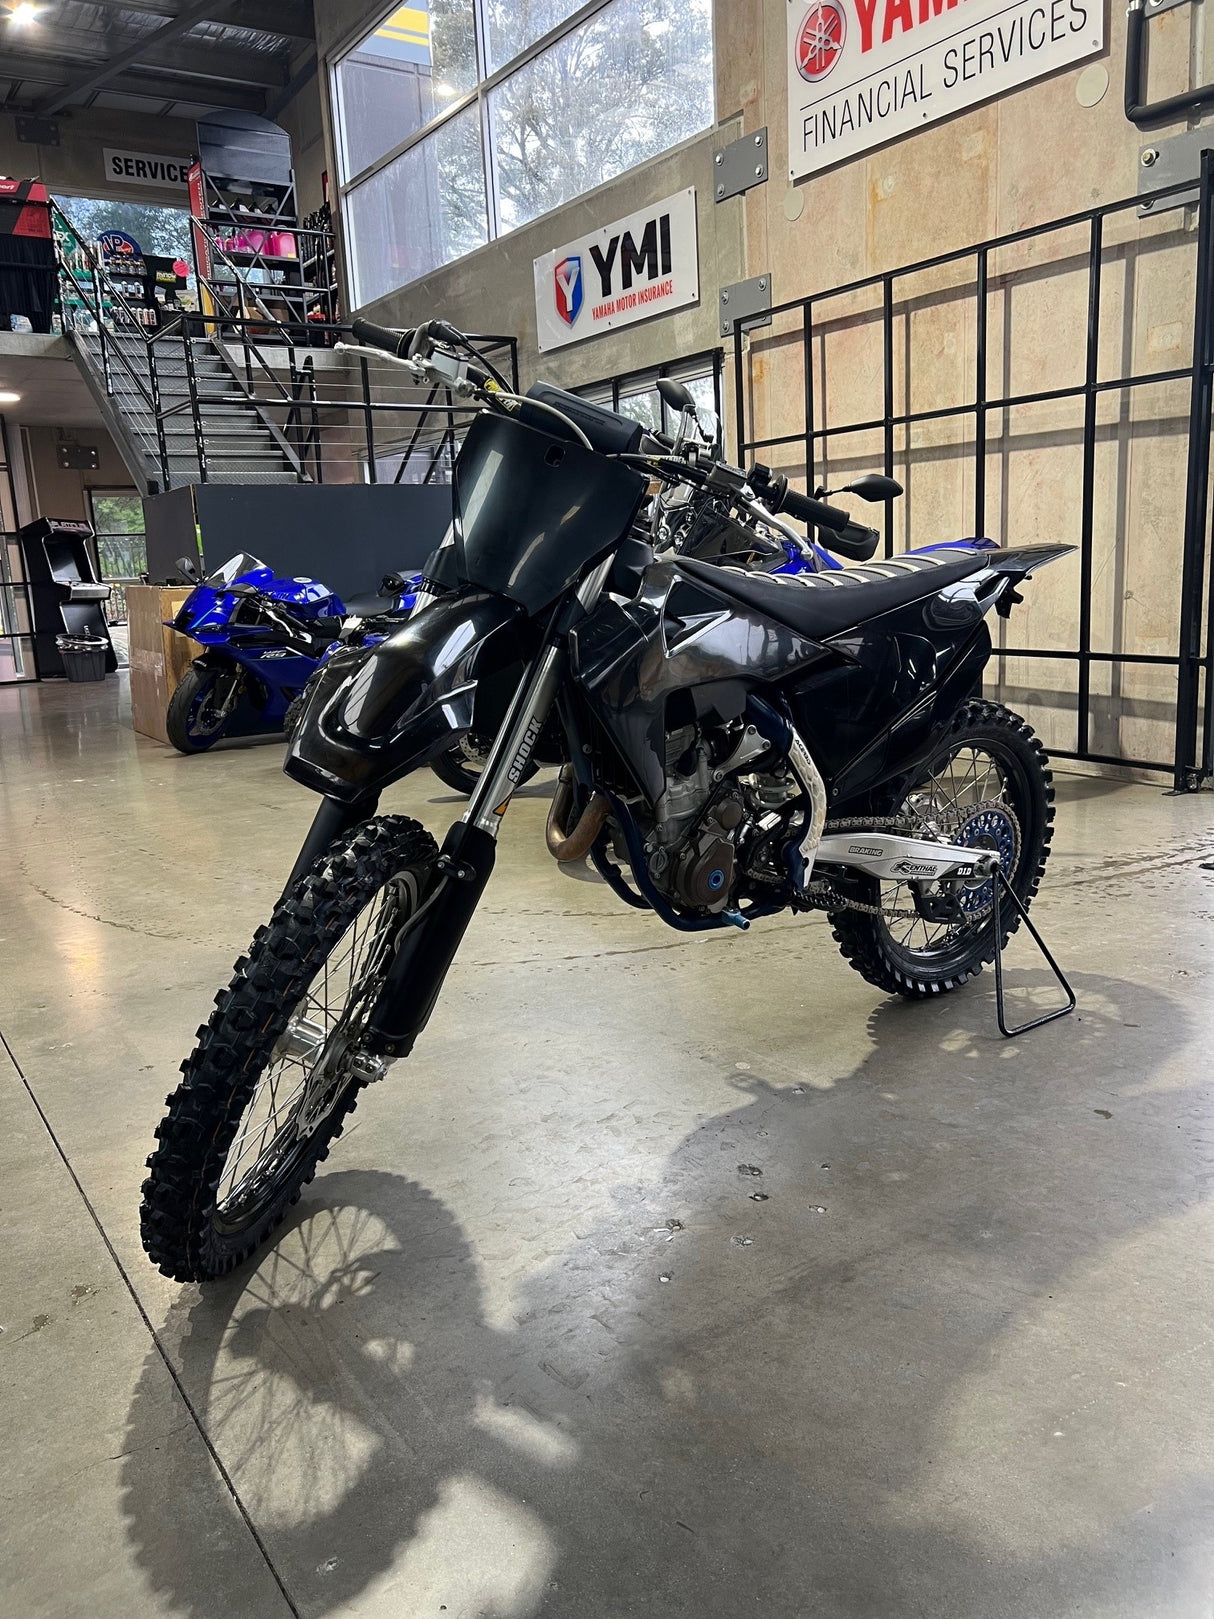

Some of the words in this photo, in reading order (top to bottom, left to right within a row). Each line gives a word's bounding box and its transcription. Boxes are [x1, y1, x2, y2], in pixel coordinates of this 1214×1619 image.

[802, 63, 932, 152] FINANCIAL
[943, 0, 1088, 88] SERVICES
[111, 156, 189, 183] SERVICE
[588, 213, 672, 298] YMI
[592, 301, 615, 320] YAMAHA
[616, 293, 637, 312] MOTOR
[638, 280, 673, 305] INSURANCE
[508, 714, 543, 784] SHOCK
[849, 846, 883, 856] BRAKING
